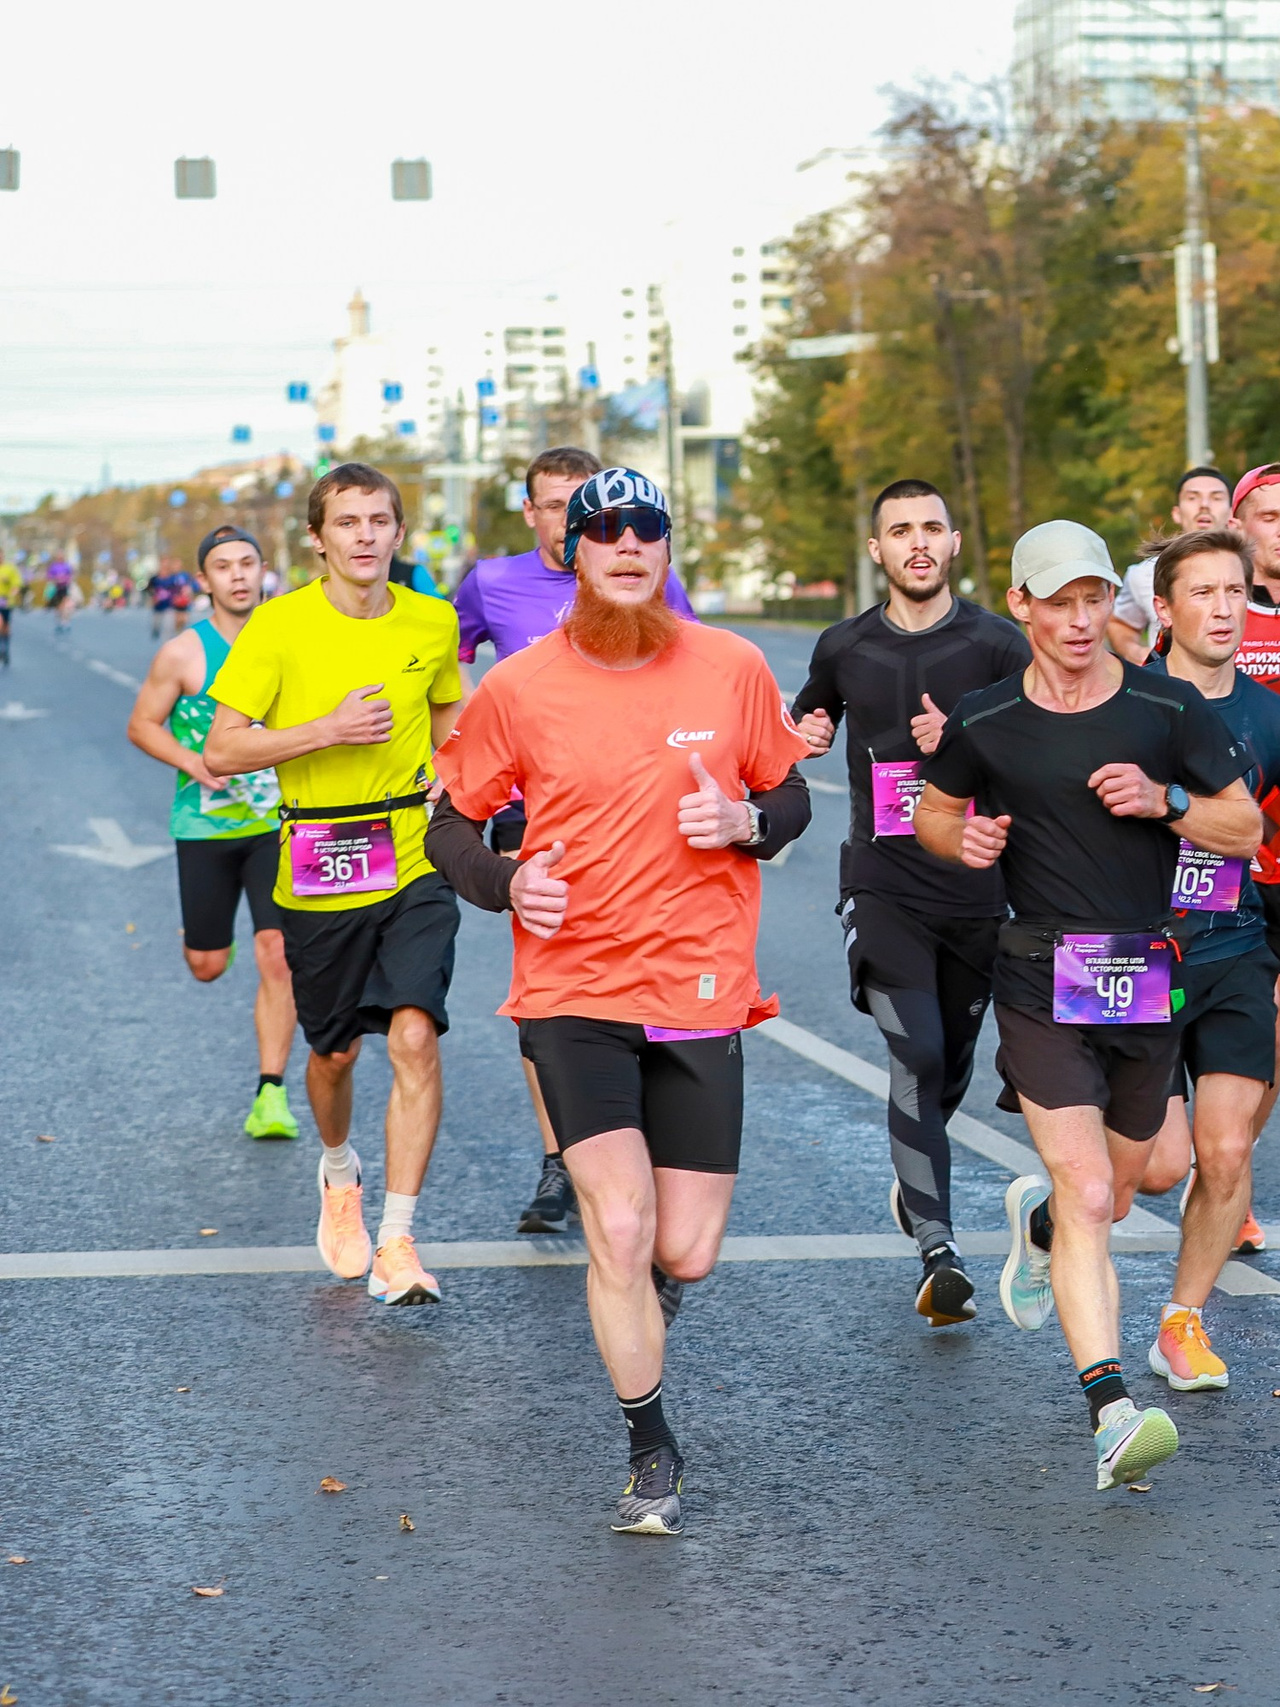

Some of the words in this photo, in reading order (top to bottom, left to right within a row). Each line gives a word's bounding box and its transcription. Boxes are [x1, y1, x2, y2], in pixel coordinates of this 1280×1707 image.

[1242, 640, 1264, 648] PARIS
[674, 730, 716, 742] КАНТ
[318, 853, 370, 882] 367
[1172, 865, 1217, 897] 105
[1096, 975, 1134, 1009] 49
